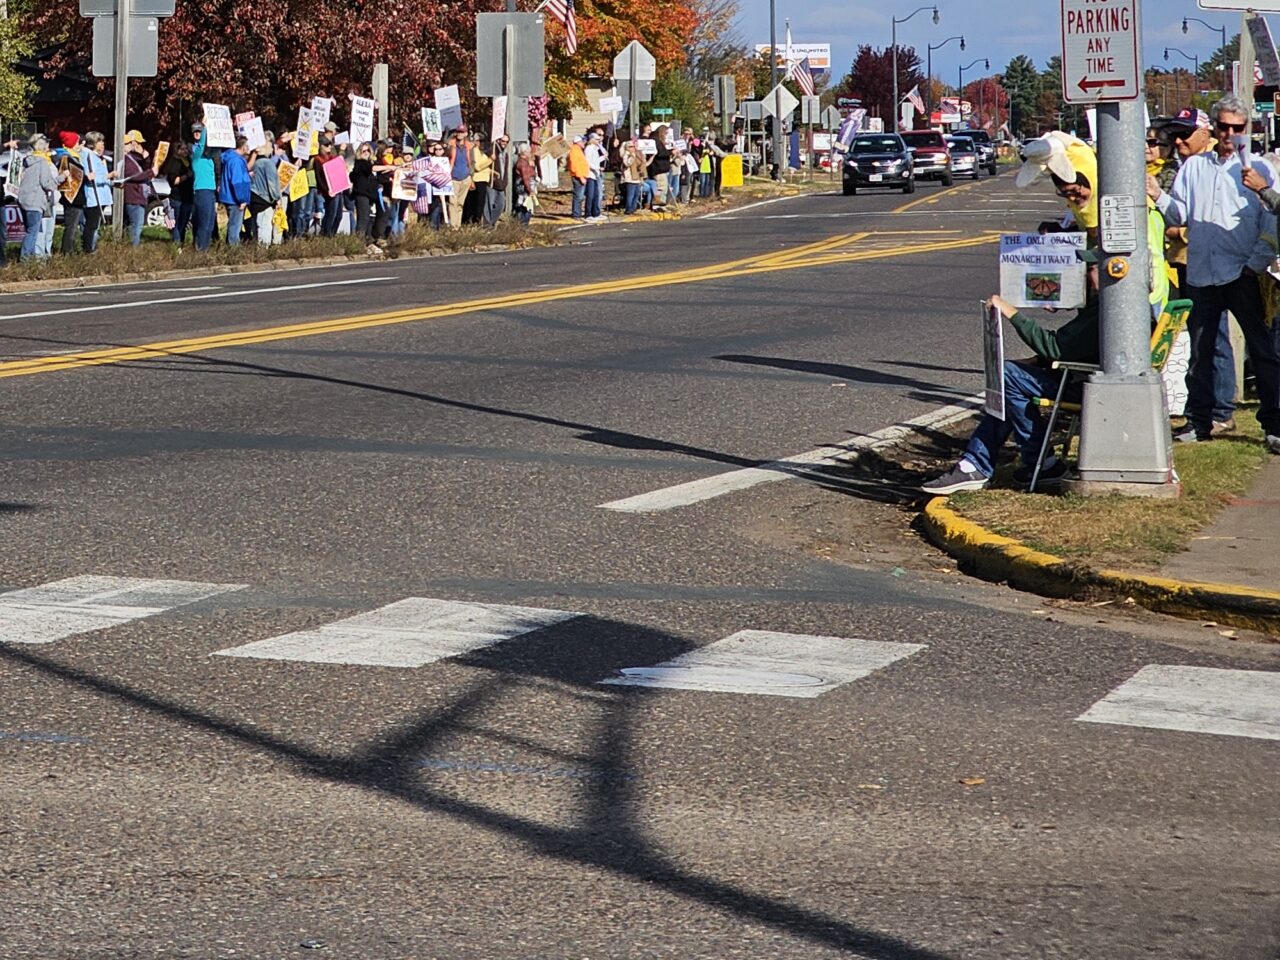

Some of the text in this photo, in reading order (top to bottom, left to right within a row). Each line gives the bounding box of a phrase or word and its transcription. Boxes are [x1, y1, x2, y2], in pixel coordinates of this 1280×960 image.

[1067, 6, 1129, 34] PARKING
[1086, 36, 1111, 54] ANY
[1085, 56, 1115, 74] TIME
[1004, 235, 1084, 245] THE ONLY ORANGE
[1001, 254, 1041, 264] MONARCH
[1043, 255, 1047, 264] I
[1047, 255, 1072, 264] WANT
